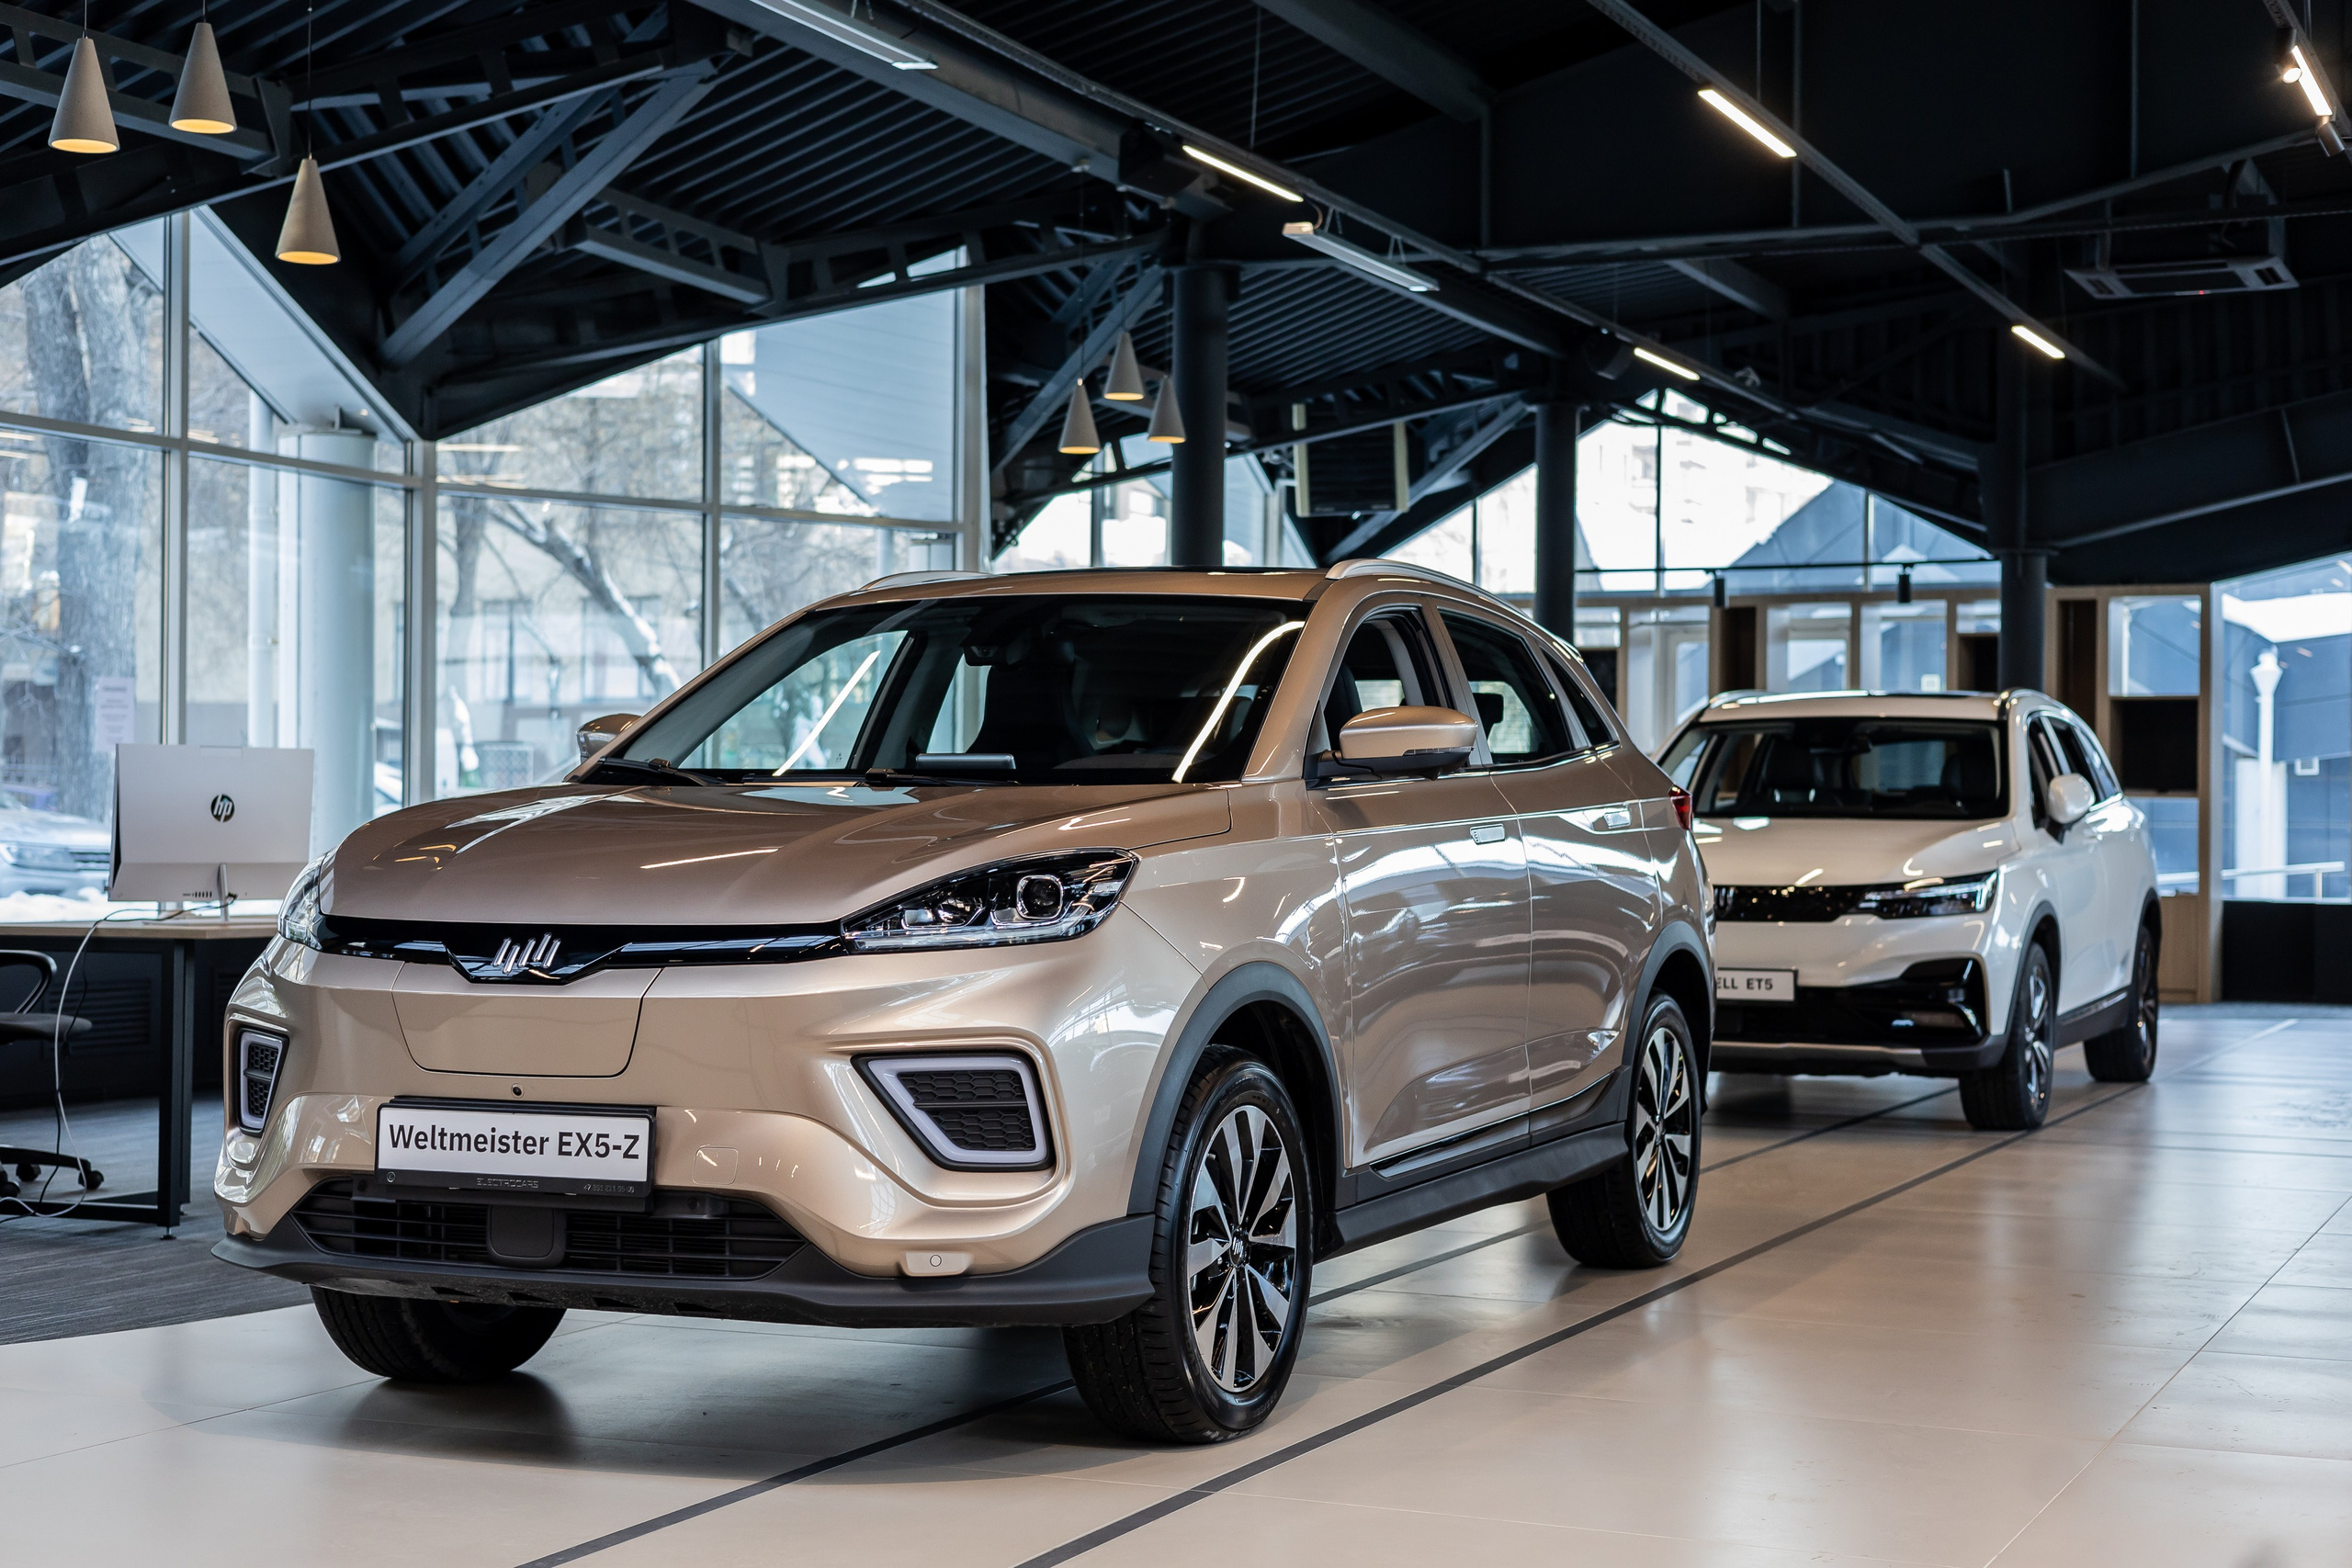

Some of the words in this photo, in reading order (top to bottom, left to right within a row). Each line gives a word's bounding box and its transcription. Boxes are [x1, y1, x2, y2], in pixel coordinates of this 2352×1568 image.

[212, 794, 233, 823] hp
[1746, 977, 1773, 991] ET5
[389, 1124, 549, 1156] Weltmeister
[558, 1131, 639, 1159] EX5-Z
[477, 1178, 539, 1189] ELECTROCARS
